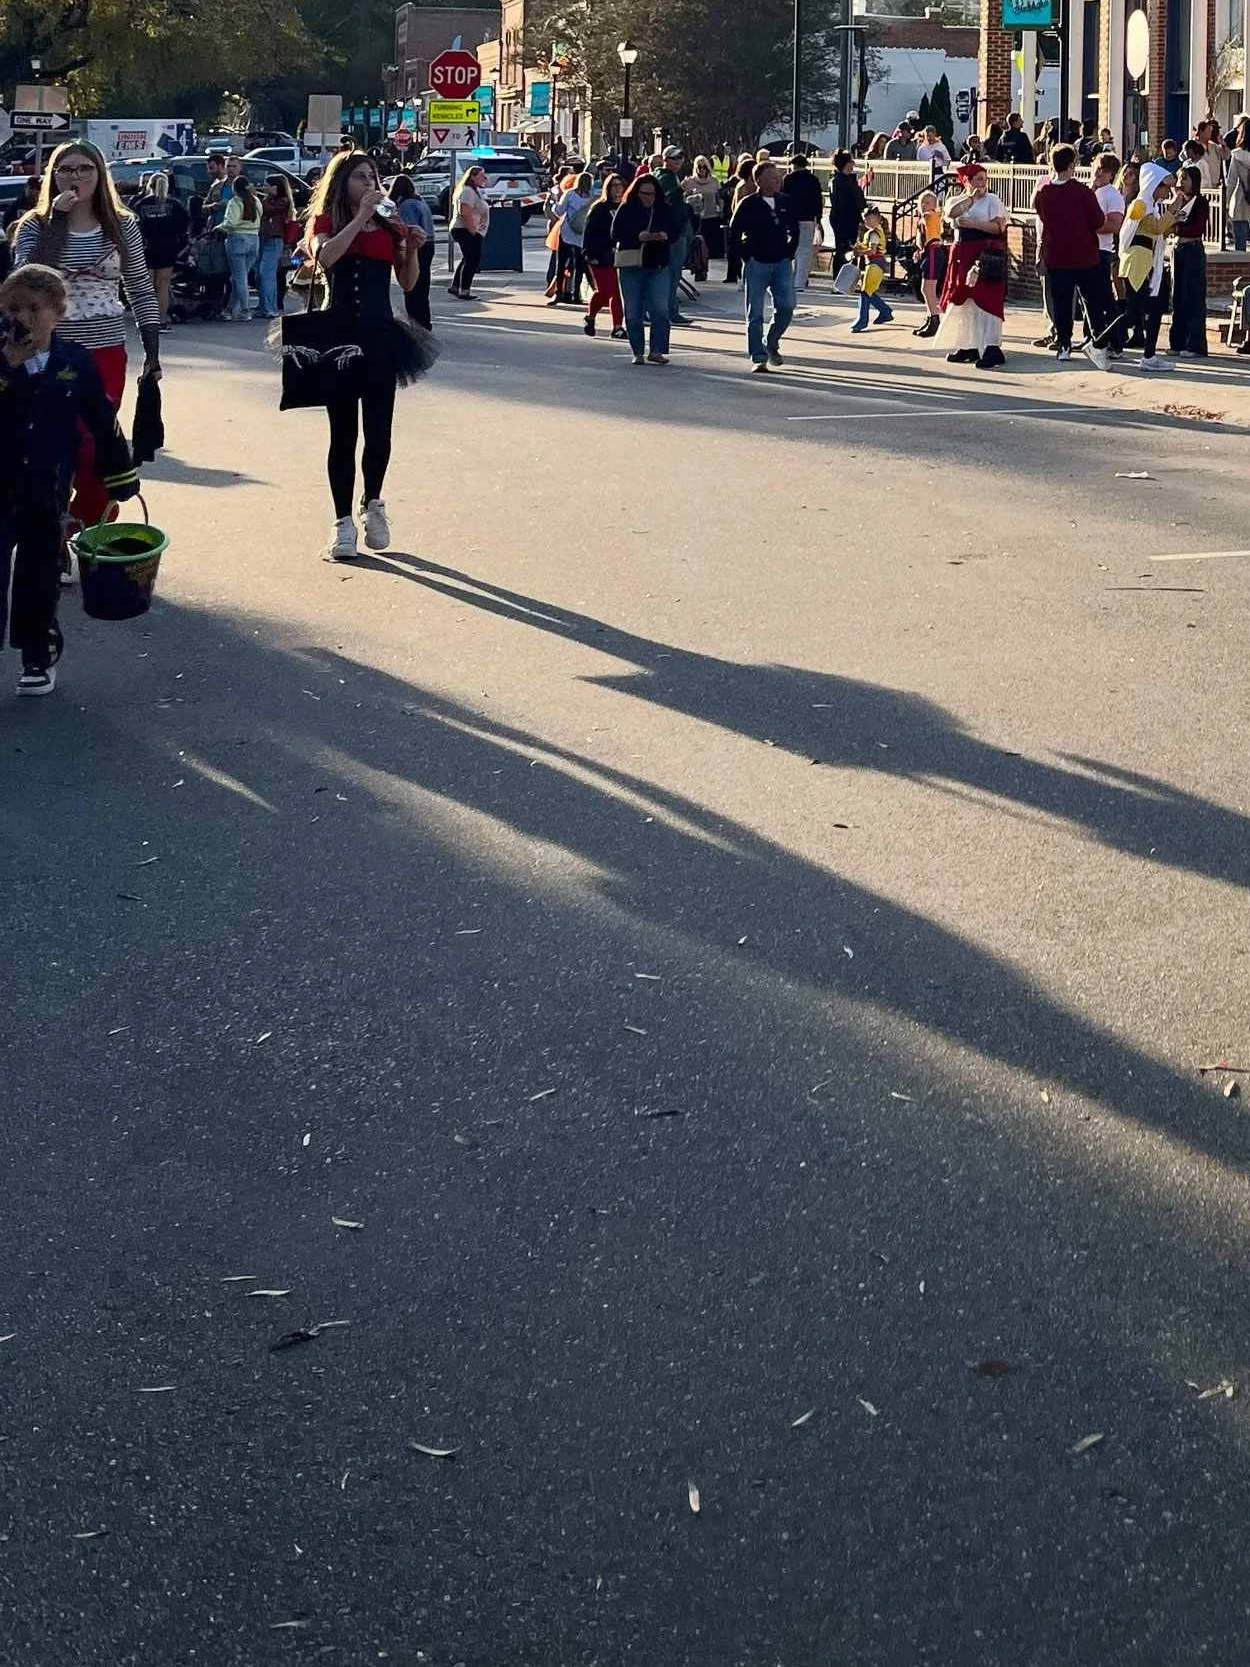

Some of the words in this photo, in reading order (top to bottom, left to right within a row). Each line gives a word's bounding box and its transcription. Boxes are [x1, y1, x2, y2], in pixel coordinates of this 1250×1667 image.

[433, 66, 478, 85] STOP
[16, 116, 32, 125] ONE
[35, 116, 53, 125] WAY
[118, 133, 147, 141] UNION
[117, 140, 146, 150] EMS
